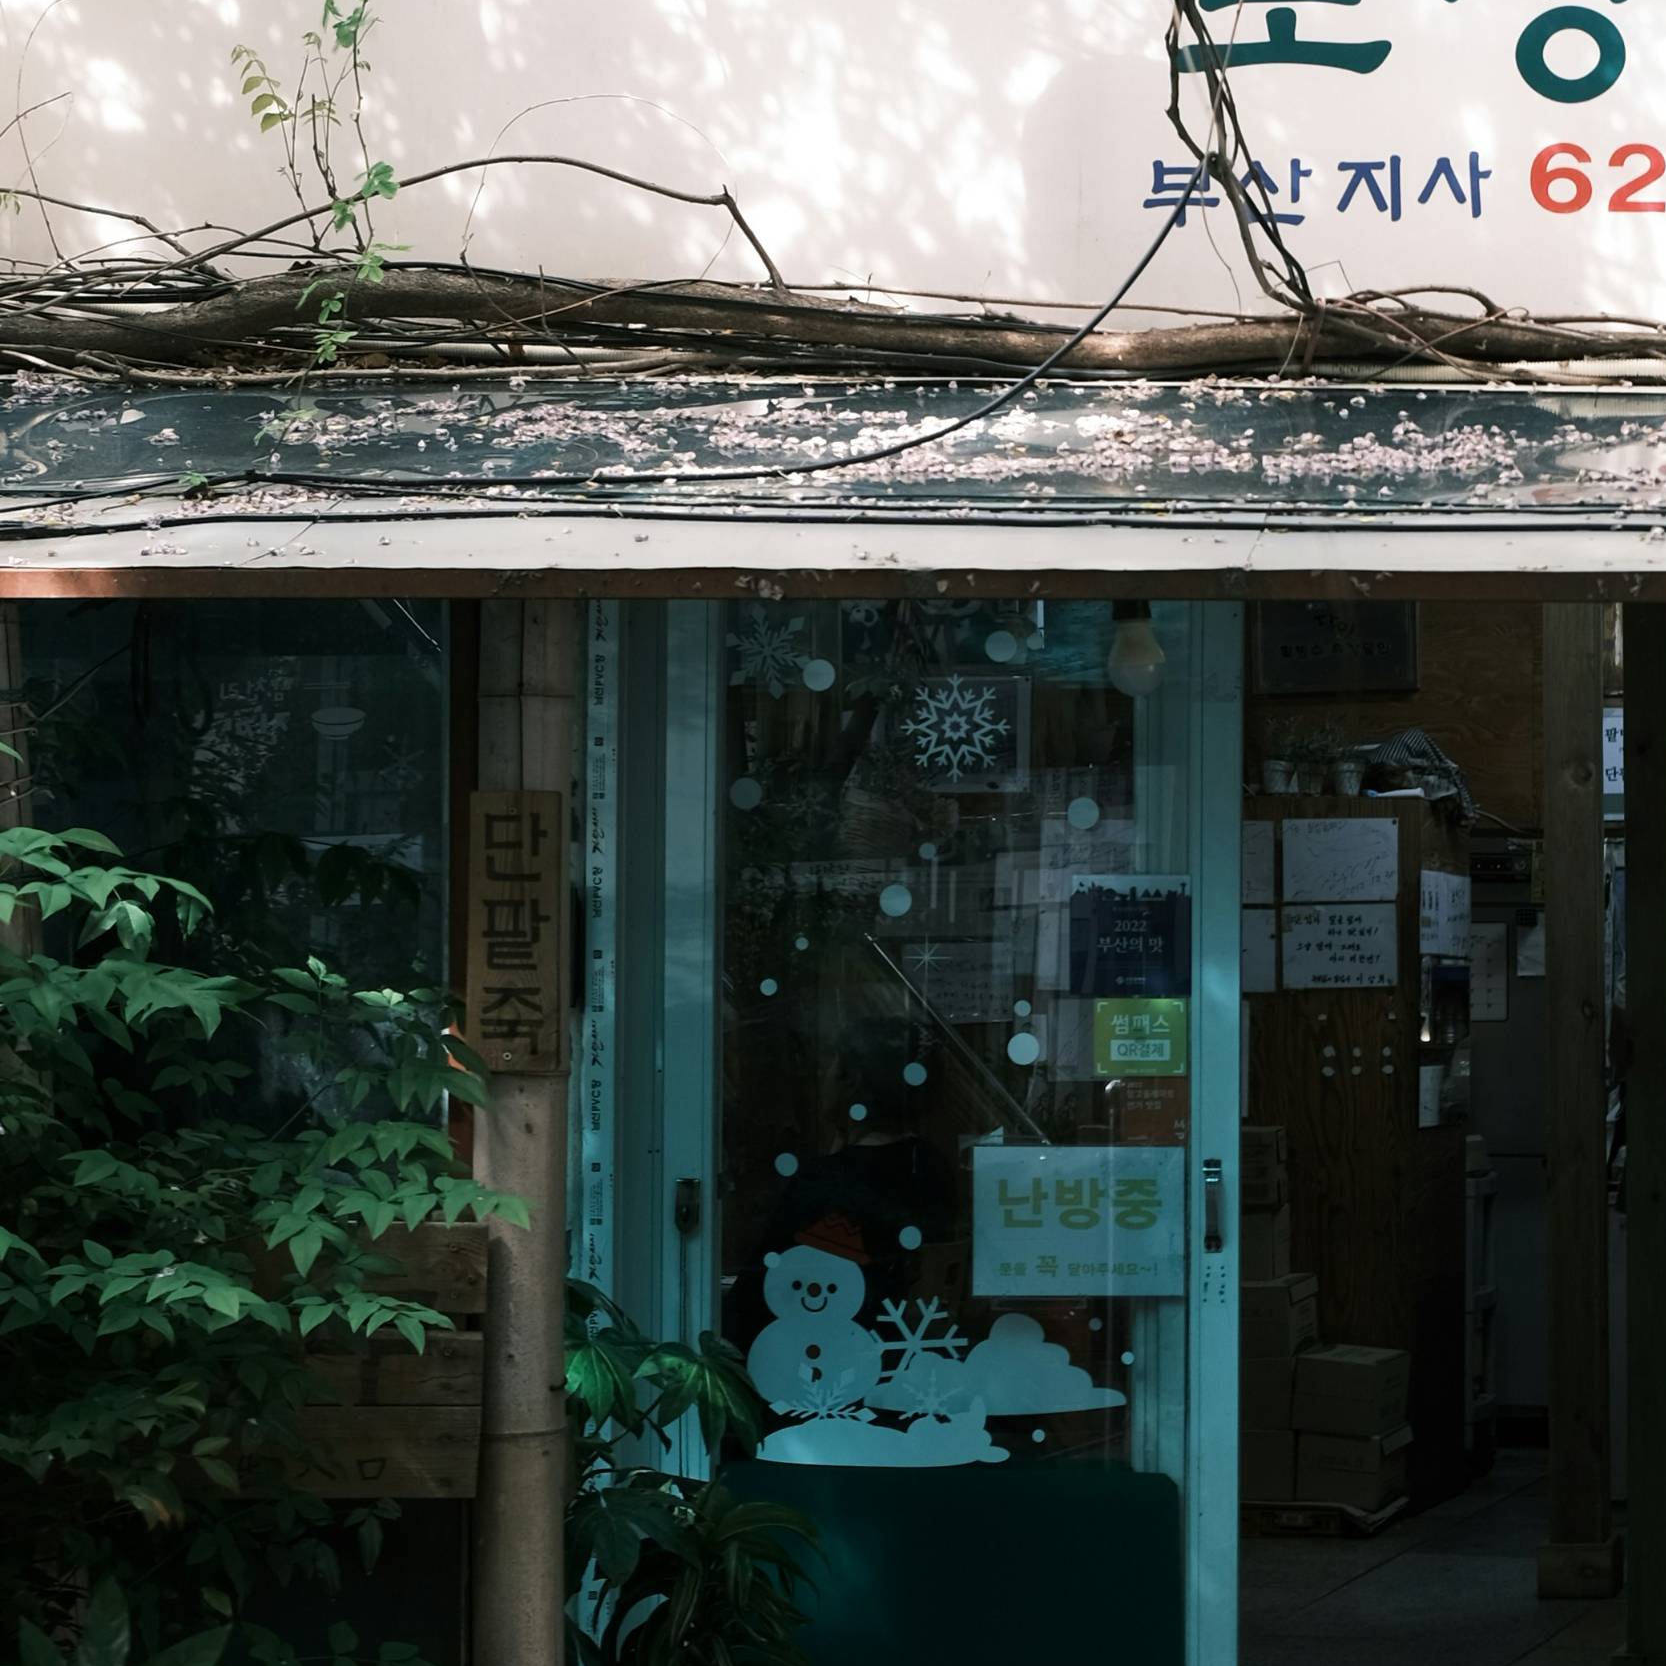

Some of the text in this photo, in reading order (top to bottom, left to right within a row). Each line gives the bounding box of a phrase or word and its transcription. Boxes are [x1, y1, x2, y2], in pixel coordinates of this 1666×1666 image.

[480, 812, 551, 1056] 단팥죽
[1113, 919, 1147, 933] 2022
[1096, 935, 1164, 954] 부산의 맛
[1116, 1042, 1165, 1058] QR결제
[998, 1177, 1163, 1230] 난방중
[999, 1262, 1027, 1277] 문을
[1035, 1255, 1059, 1278] 꼭
